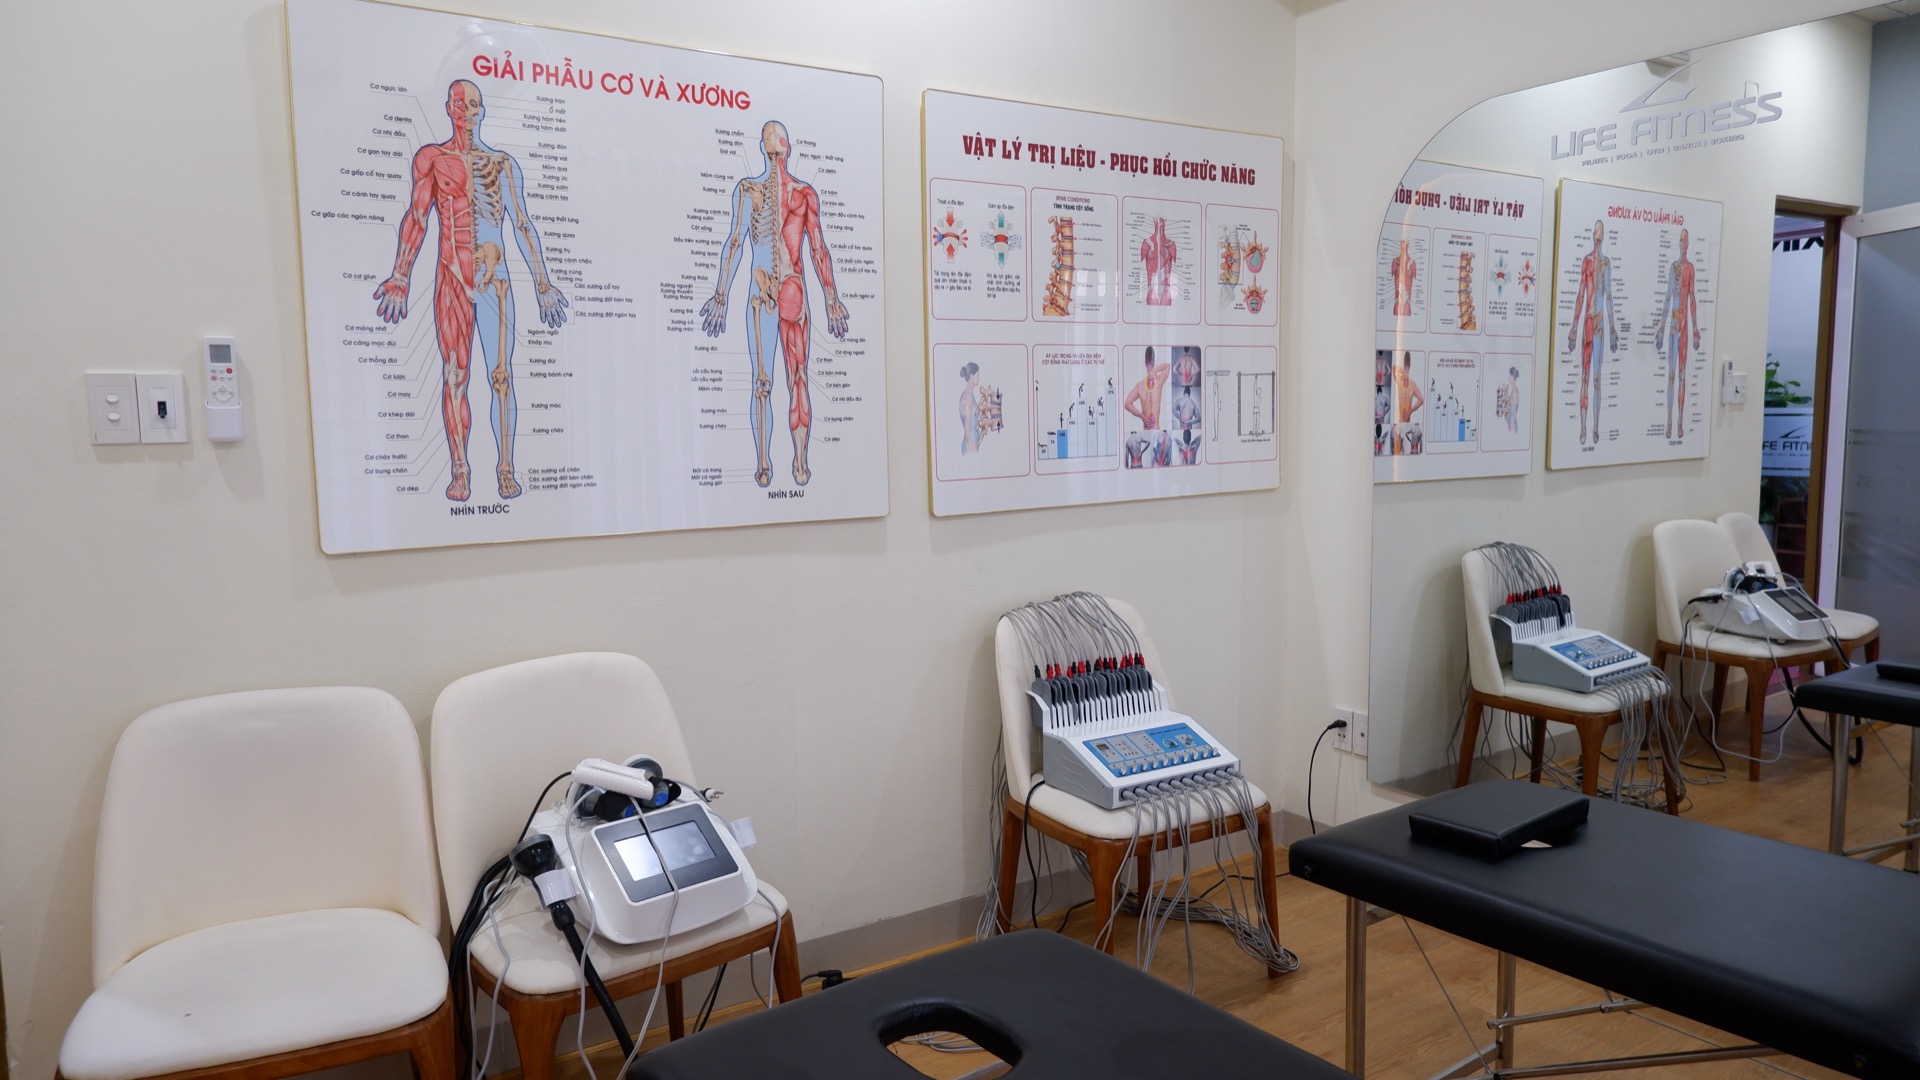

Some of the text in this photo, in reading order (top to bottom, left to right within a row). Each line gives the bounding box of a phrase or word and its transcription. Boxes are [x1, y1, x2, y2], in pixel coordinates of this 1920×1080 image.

[472, 50, 751, 111] GIẢI PHẪU CƠ VÀ XƯƠNG
[1550, 91, 1783, 161] LIFE FITNESS
[962, 131, 996, 161] VẬT
[1002, 136, 1022, 160] LÝ
[1028, 143, 1056, 169] TRỊ
[1060, 144, 1096, 172] LIỆU
[1110, 152, 1149, 178] PHỤC
[1153, 152, 1177, 178] HỒI
[1181, 158, 1217, 182] CHỨC
[1221, 163, 1256, 186] NĂNG
[1762, 441, 1812, 451] FE FITN
[450, 503, 510, 516] NHÌN TRƯỚC
[768, 489, 804, 499] NHÌN SAU
